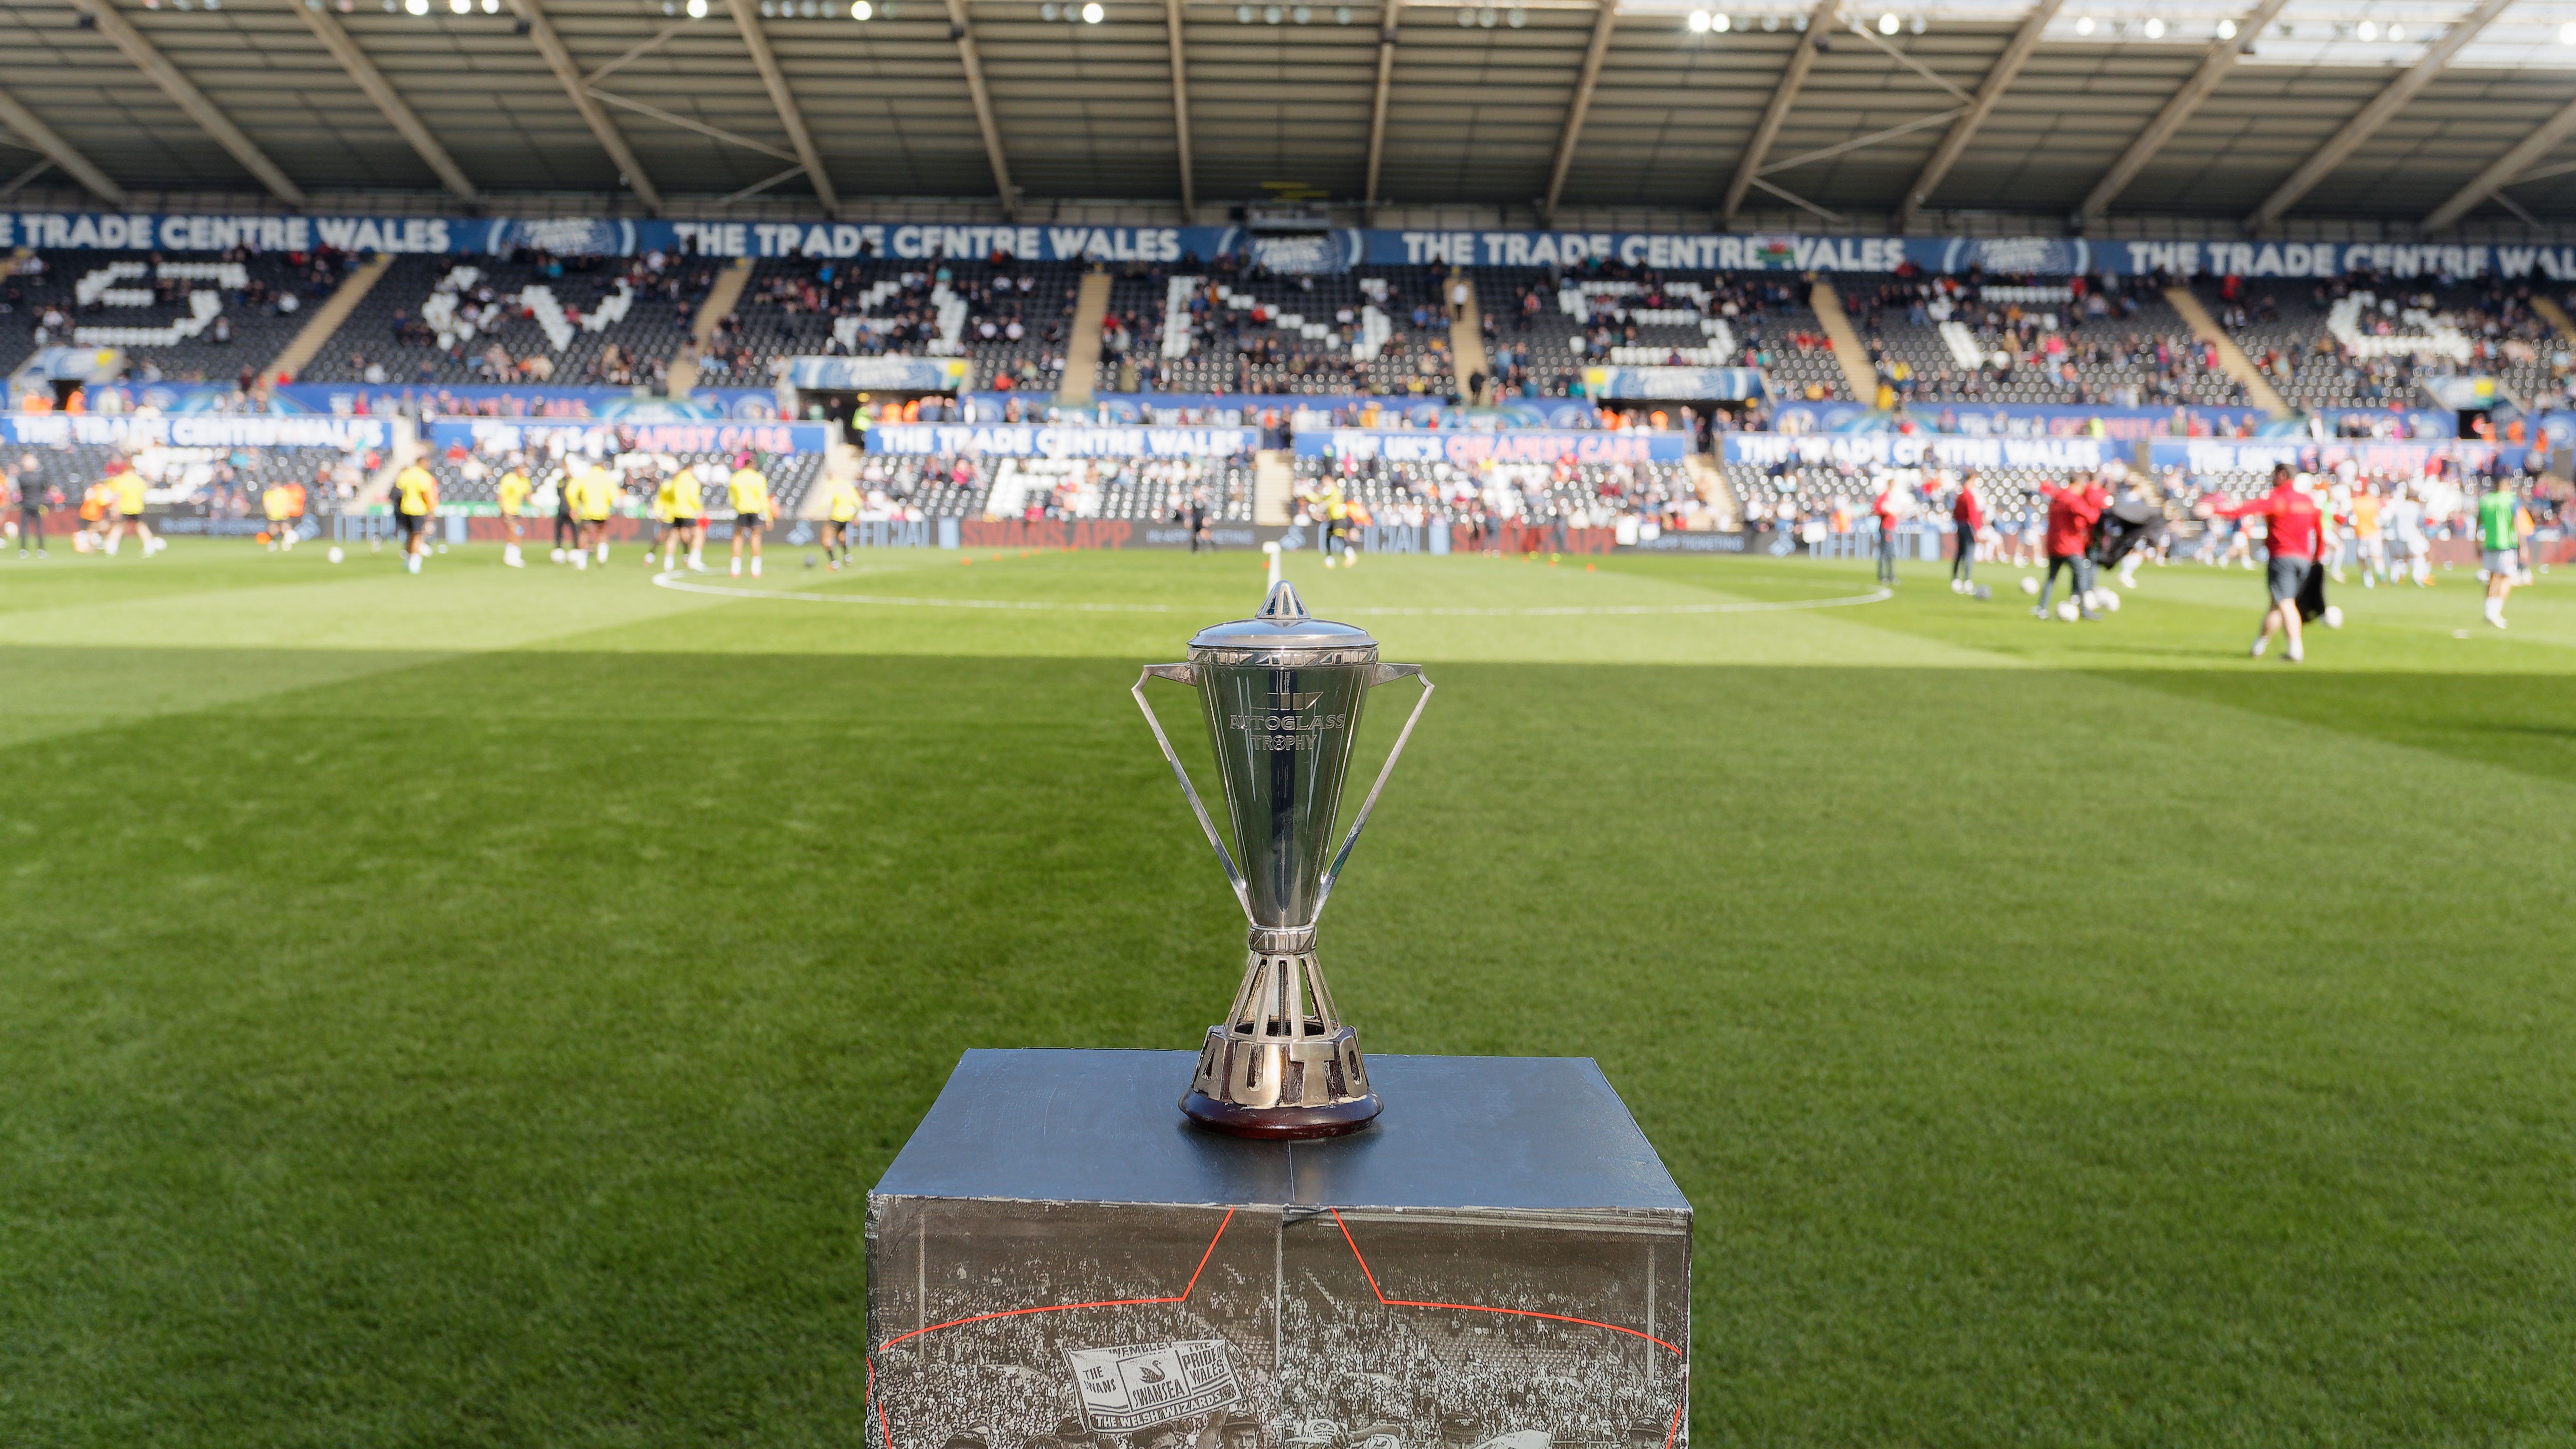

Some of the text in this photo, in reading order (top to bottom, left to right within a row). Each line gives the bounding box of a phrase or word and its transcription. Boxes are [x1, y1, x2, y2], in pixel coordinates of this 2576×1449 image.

[21, 215, 153, 250] TRADE
[160, 216, 309, 251] CENTRE
[317, 218, 451, 254] WALES
[673, 222, 1180, 262] THE TRADE CENTRE WALES
[1402, 232, 1474, 266] THE
[1483, 232, 1612, 267] TRADE
[1620, 234, 1763, 269] CENTRE
[2127, 242, 2199, 275] THE
[2207, 242, 2336, 276] TRADE
[2344, 244, 2488, 278] CENTRE
[878, 427, 1244, 457] THE TRADE CENTRE WALES
[1578, 436, 1651, 462] CARS
[2004, 439, 2099, 466] WALES
[961, 521, 1132, 548] SWANS APP
[1229, 714, 1346, 731] AUTOGLASS
[1250, 734, 1318, 751] TROPHY
[1191, 1032, 1369, 1108] AUTO
[1182, 1347, 1216, 1370] PRIDE
[1189, 1359, 1225, 1385] WALES
[1083, 1366, 1104, 1380] THE
[1132, 1379, 1186, 1408] SWANSEA
[1095, 1392, 1221, 1427] THE WELSH WIZARDS
